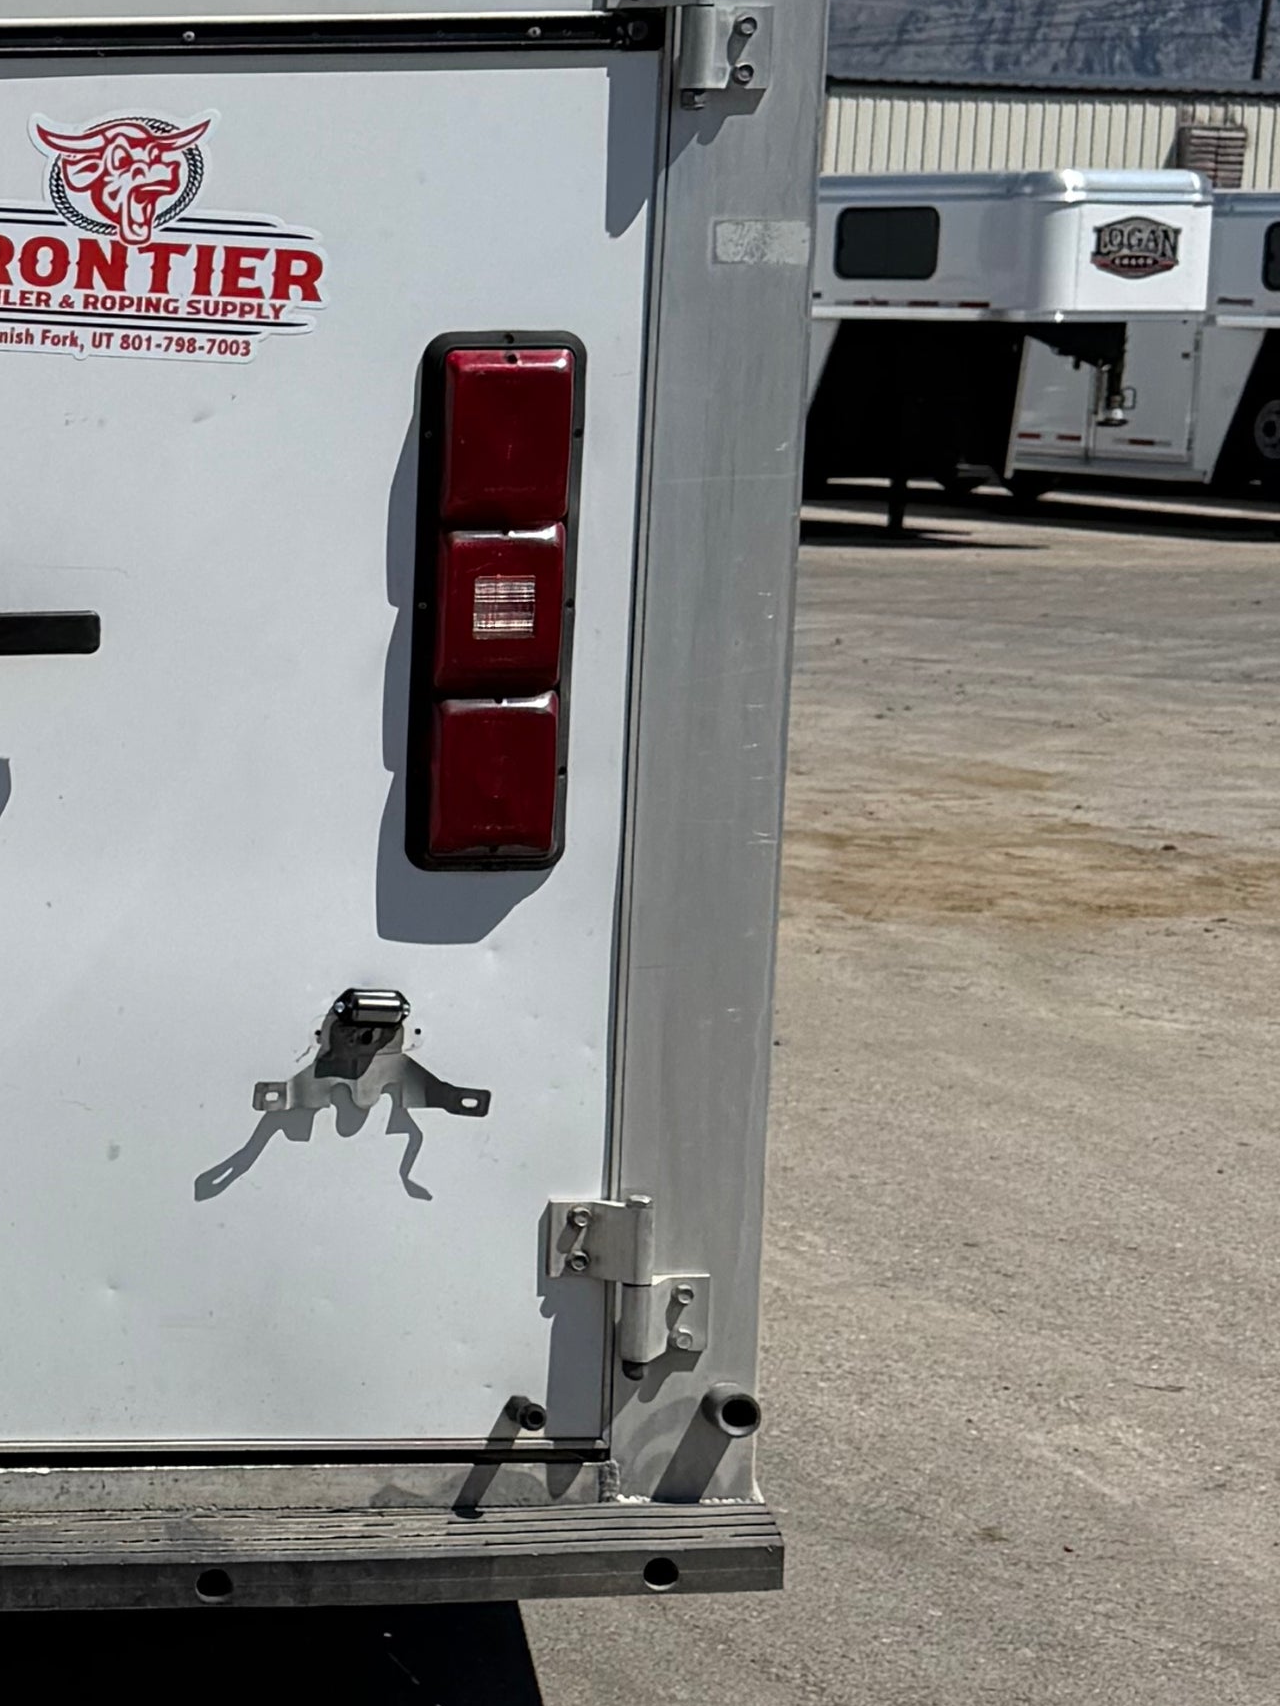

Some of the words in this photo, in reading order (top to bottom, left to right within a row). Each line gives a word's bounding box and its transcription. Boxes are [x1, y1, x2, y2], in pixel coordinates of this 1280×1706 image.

[1091, 225, 1182, 258] LOGAN
[58, 295, 76, 309] &
[83, 294, 180, 314] ROPING
[186, 299, 286, 320] SUPPLY
[40, 329, 85, 352] Fork,
[91, 332, 115, 349] UT
[120, 335, 251, 356] 801-798-7003
